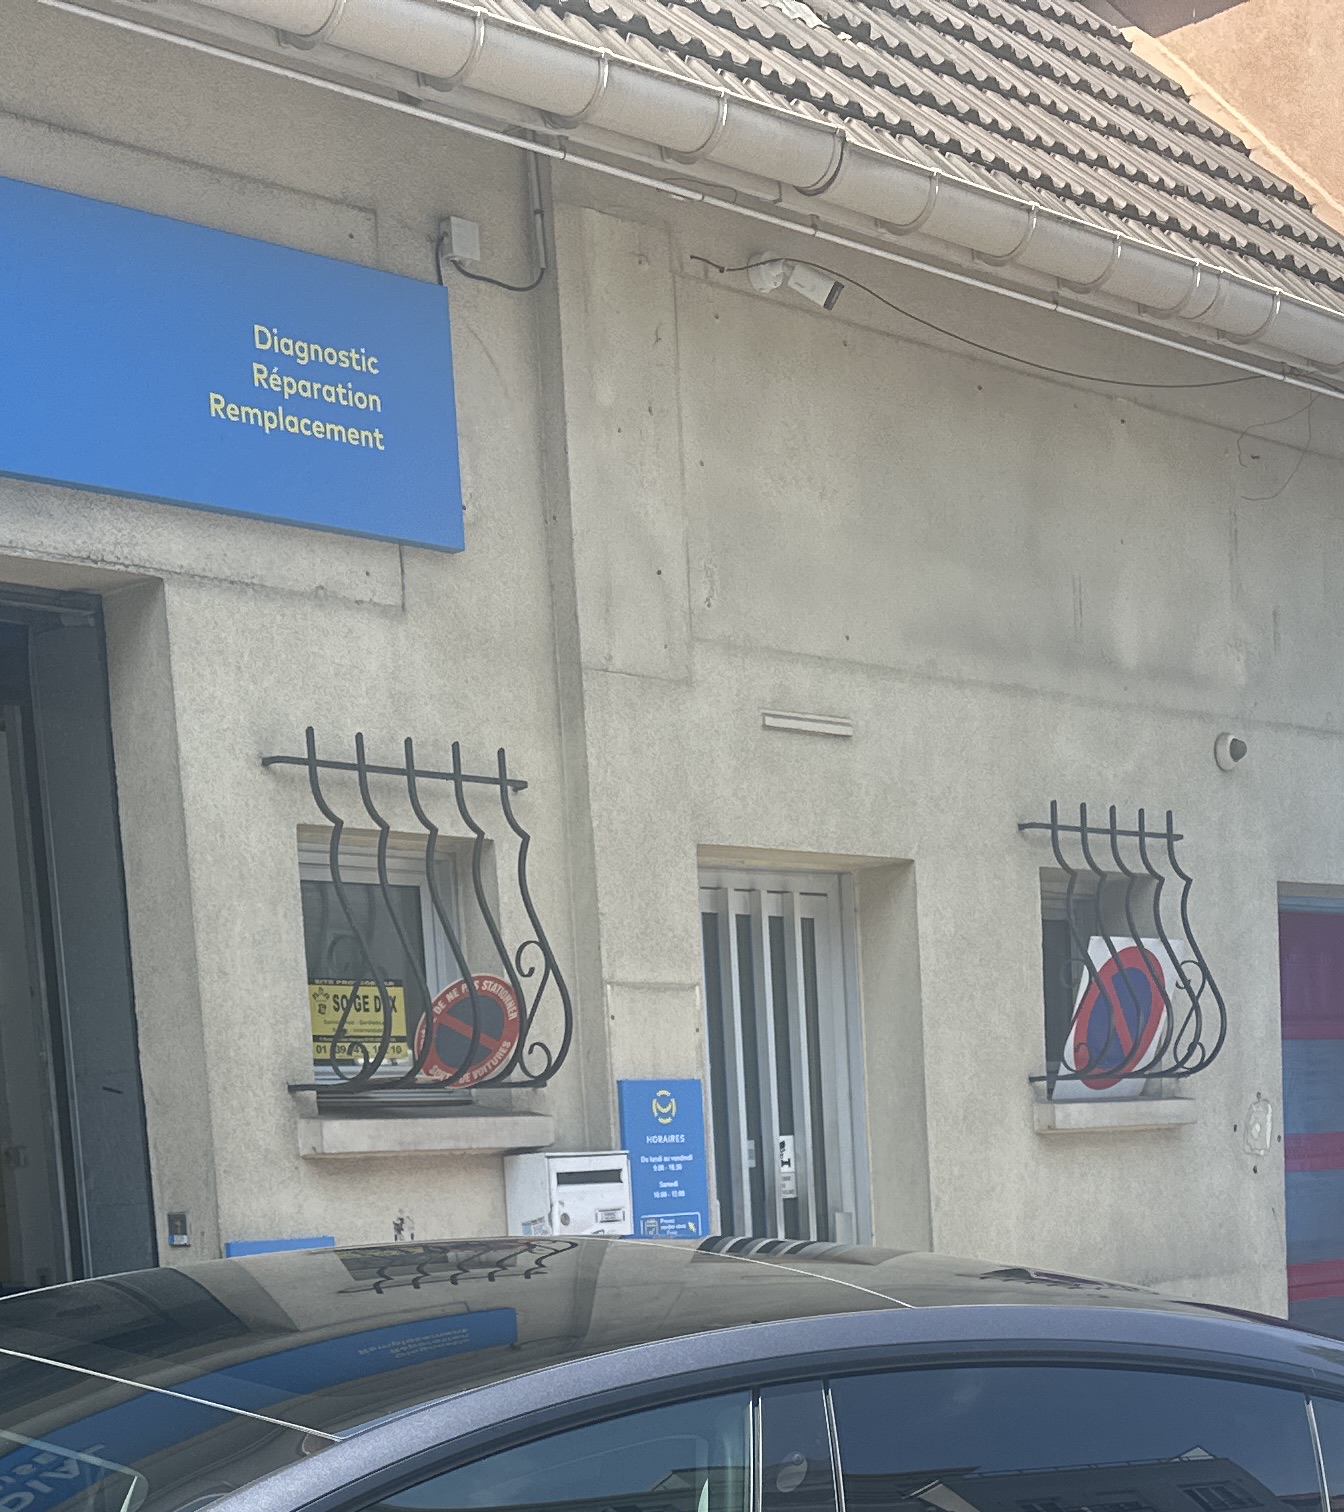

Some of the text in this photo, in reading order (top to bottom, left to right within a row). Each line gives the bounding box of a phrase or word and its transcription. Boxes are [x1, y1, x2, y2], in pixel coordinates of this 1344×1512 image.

[253, 324, 379, 375] Diagnostic
[252, 362, 382, 412] Réparation
[209, 392, 385, 450] Remplacement
[646, 1133, 685, 1144] HORAIRES
